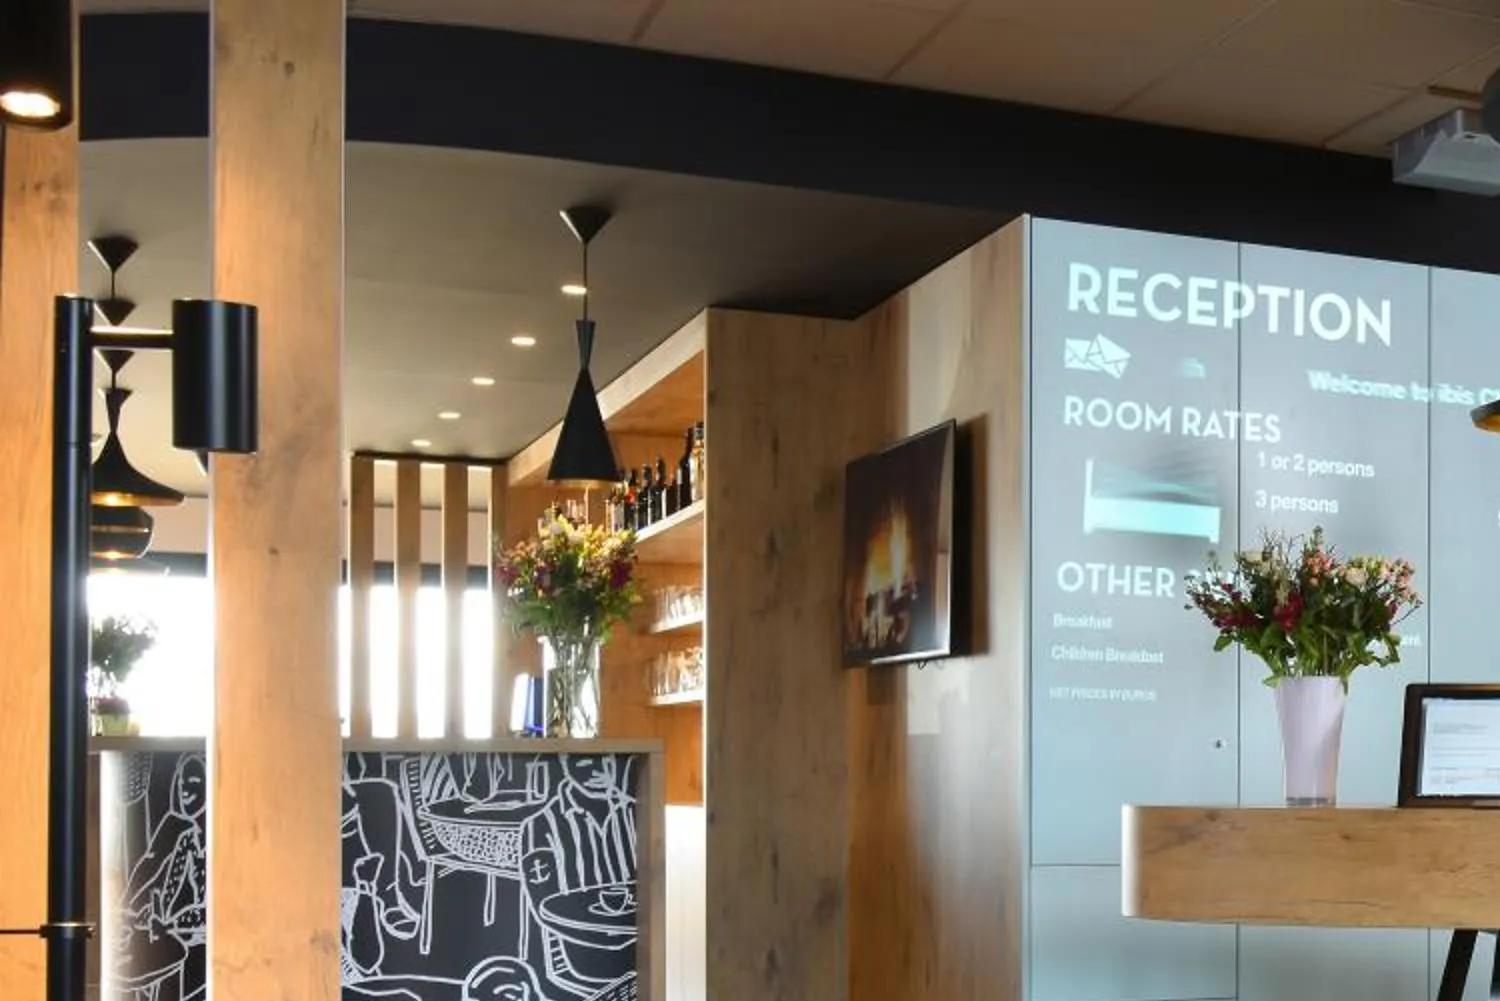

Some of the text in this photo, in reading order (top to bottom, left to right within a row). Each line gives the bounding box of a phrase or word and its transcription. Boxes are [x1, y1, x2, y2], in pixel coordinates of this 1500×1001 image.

[1068, 262, 1391, 347] RECEPTION
[1306, 368, 1406, 400] Welcome
[1063, 395, 1281, 443] ROOM RATES
[1258, 451, 1375, 477] 1 or 2 persons
[1255, 489, 1339, 515] 3 persons
[1056, 561, 1175, 598] OTHER
